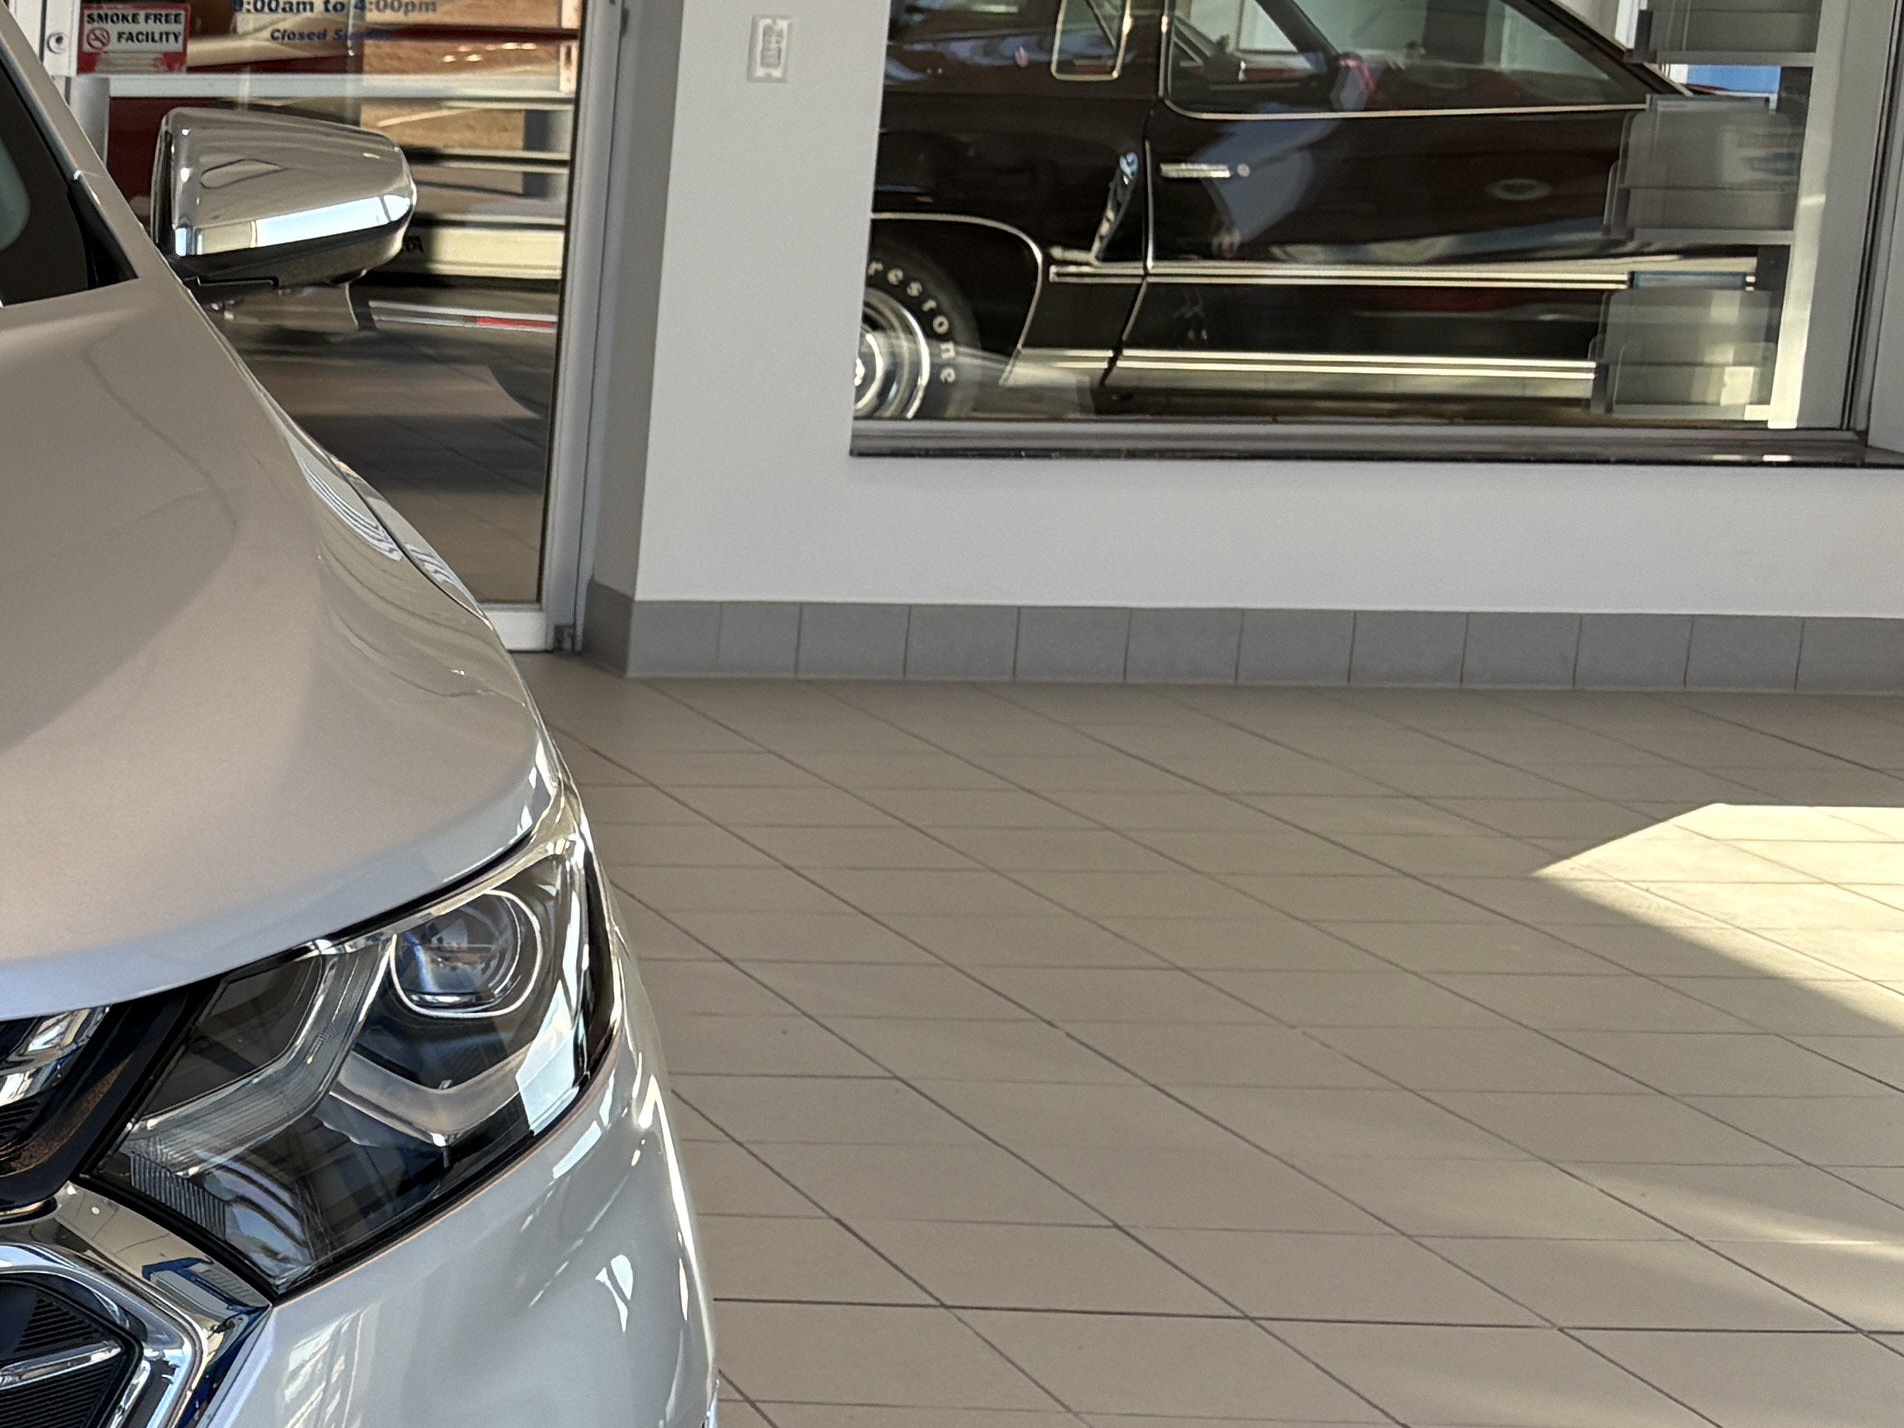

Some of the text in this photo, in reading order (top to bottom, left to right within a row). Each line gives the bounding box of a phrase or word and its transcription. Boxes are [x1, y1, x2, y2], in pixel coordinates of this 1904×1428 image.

[86, 12, 182, 25] SMOKE FREE
[117, 31, 182, 44] FACILITY
[270, 28, 327, 42] Closed
